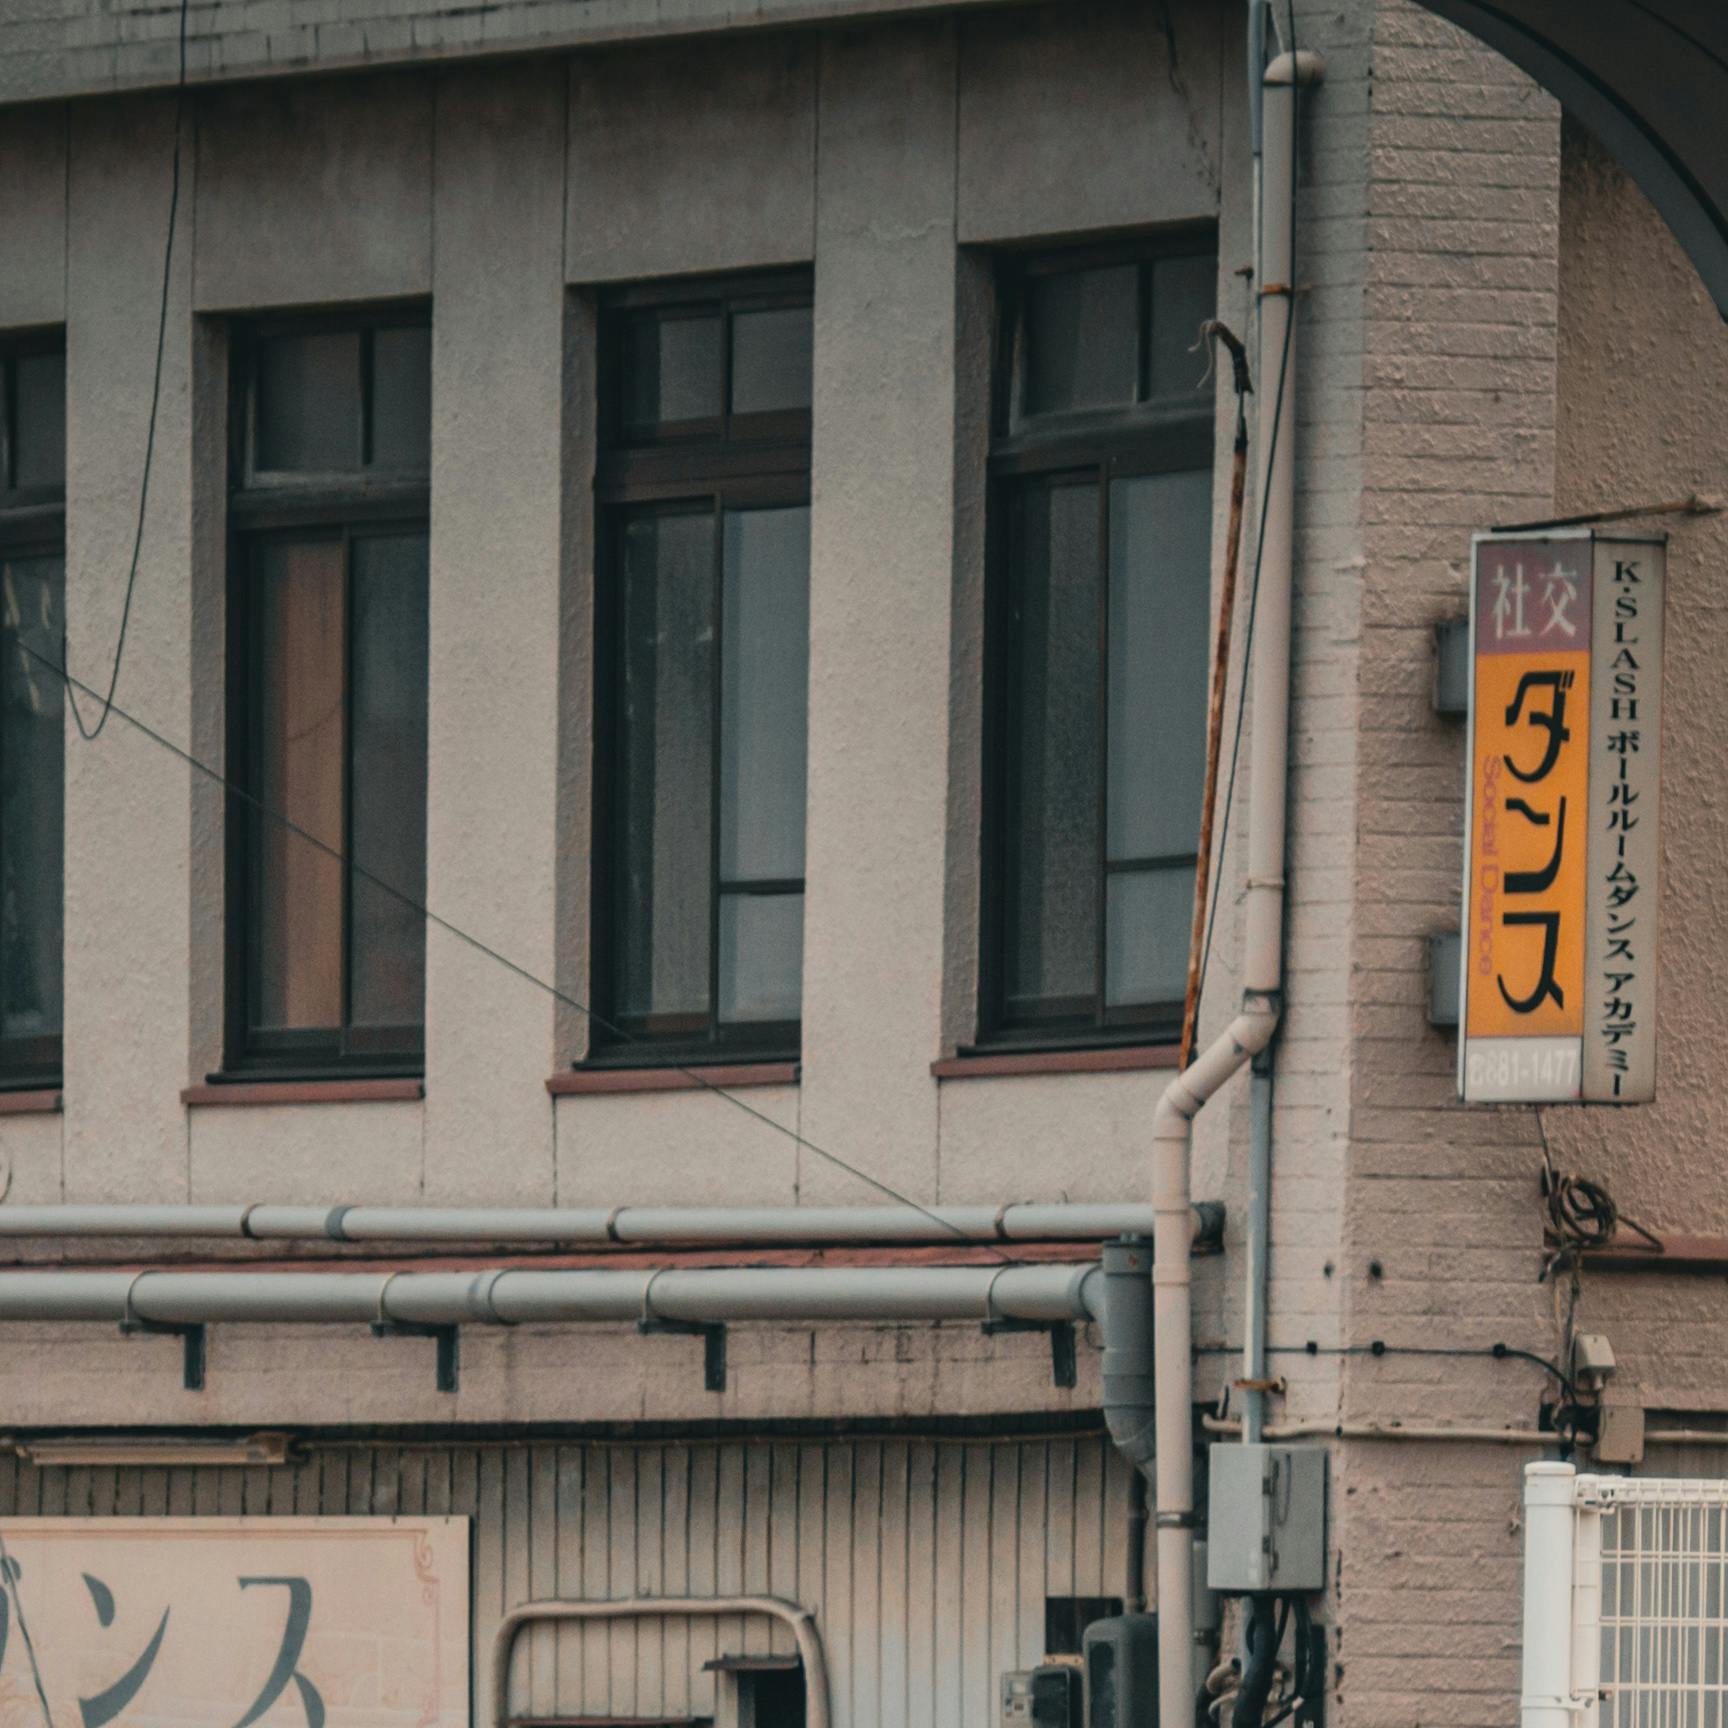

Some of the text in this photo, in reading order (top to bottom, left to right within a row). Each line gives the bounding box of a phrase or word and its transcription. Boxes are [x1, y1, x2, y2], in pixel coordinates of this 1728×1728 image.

[1491, 561, 1578, 640] 社交
[1497, 669, 1575, 1014] ダンス
